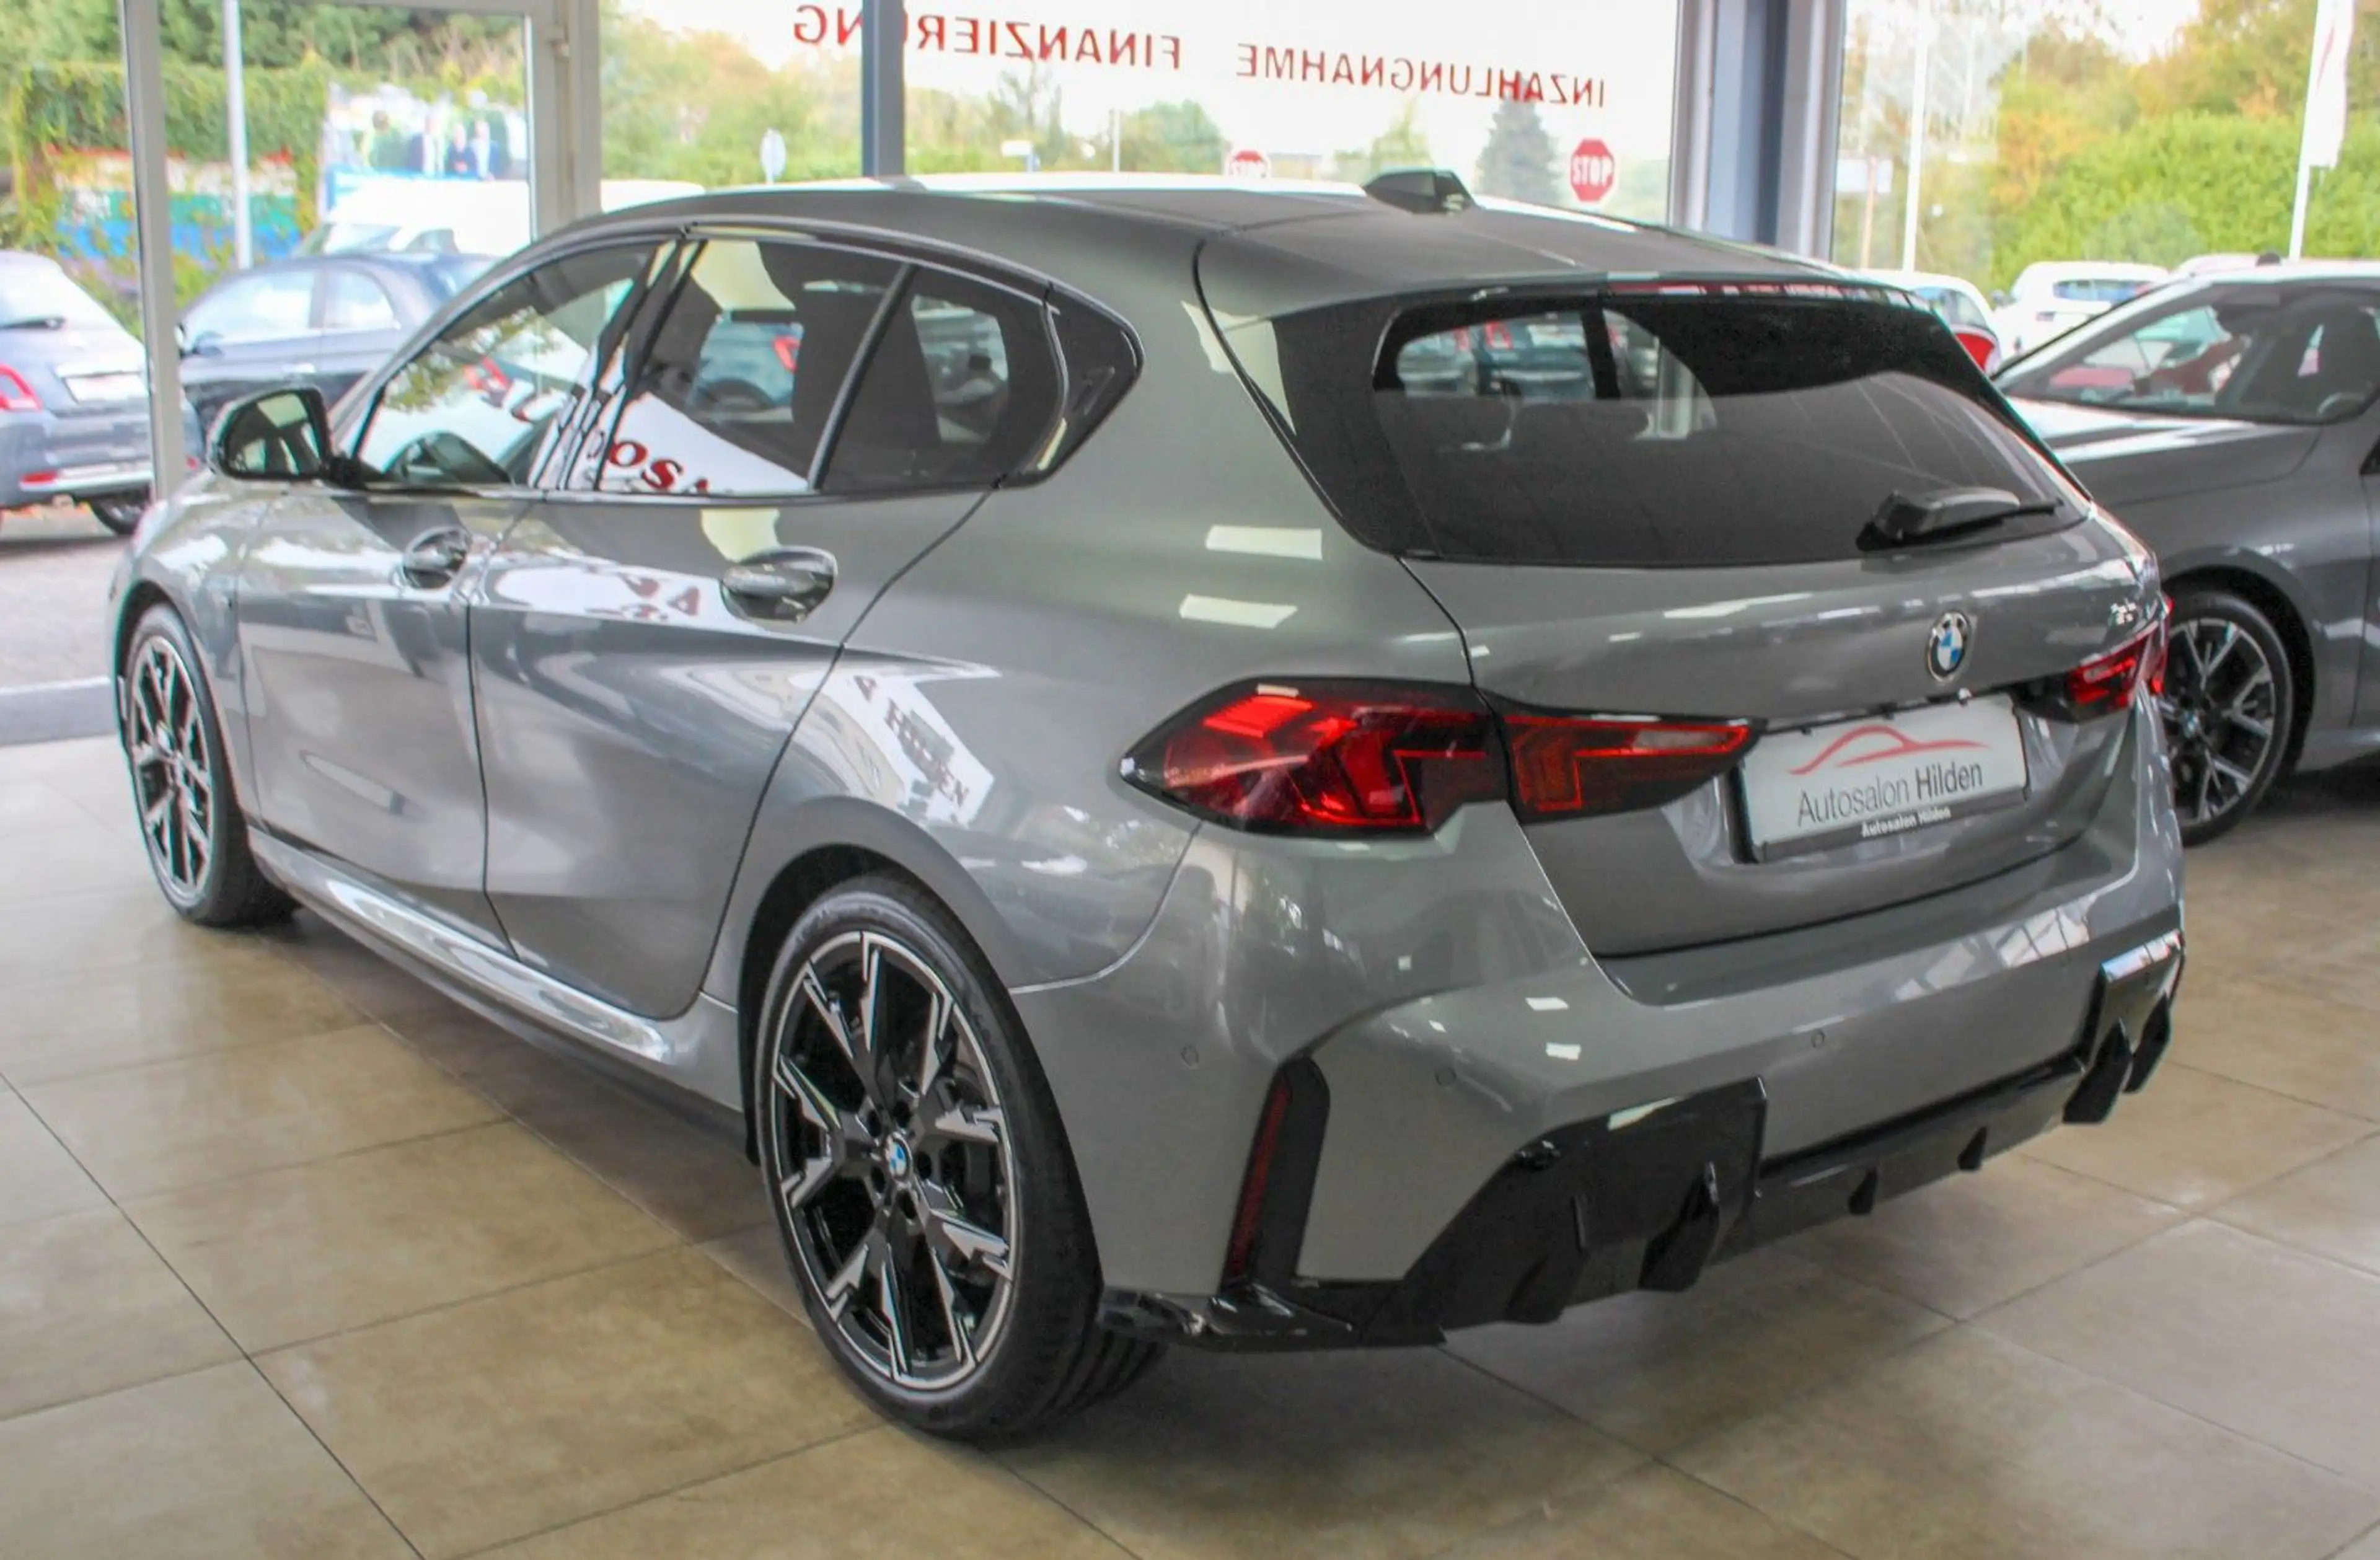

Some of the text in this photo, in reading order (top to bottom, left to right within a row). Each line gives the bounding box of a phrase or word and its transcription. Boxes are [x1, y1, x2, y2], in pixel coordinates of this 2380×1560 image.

[1572, 155, 1613, 187] STOP
[1798, 760, 1983, 827] Autosalon Hilden
[1861, 813, 1918, 838] Autosalon
